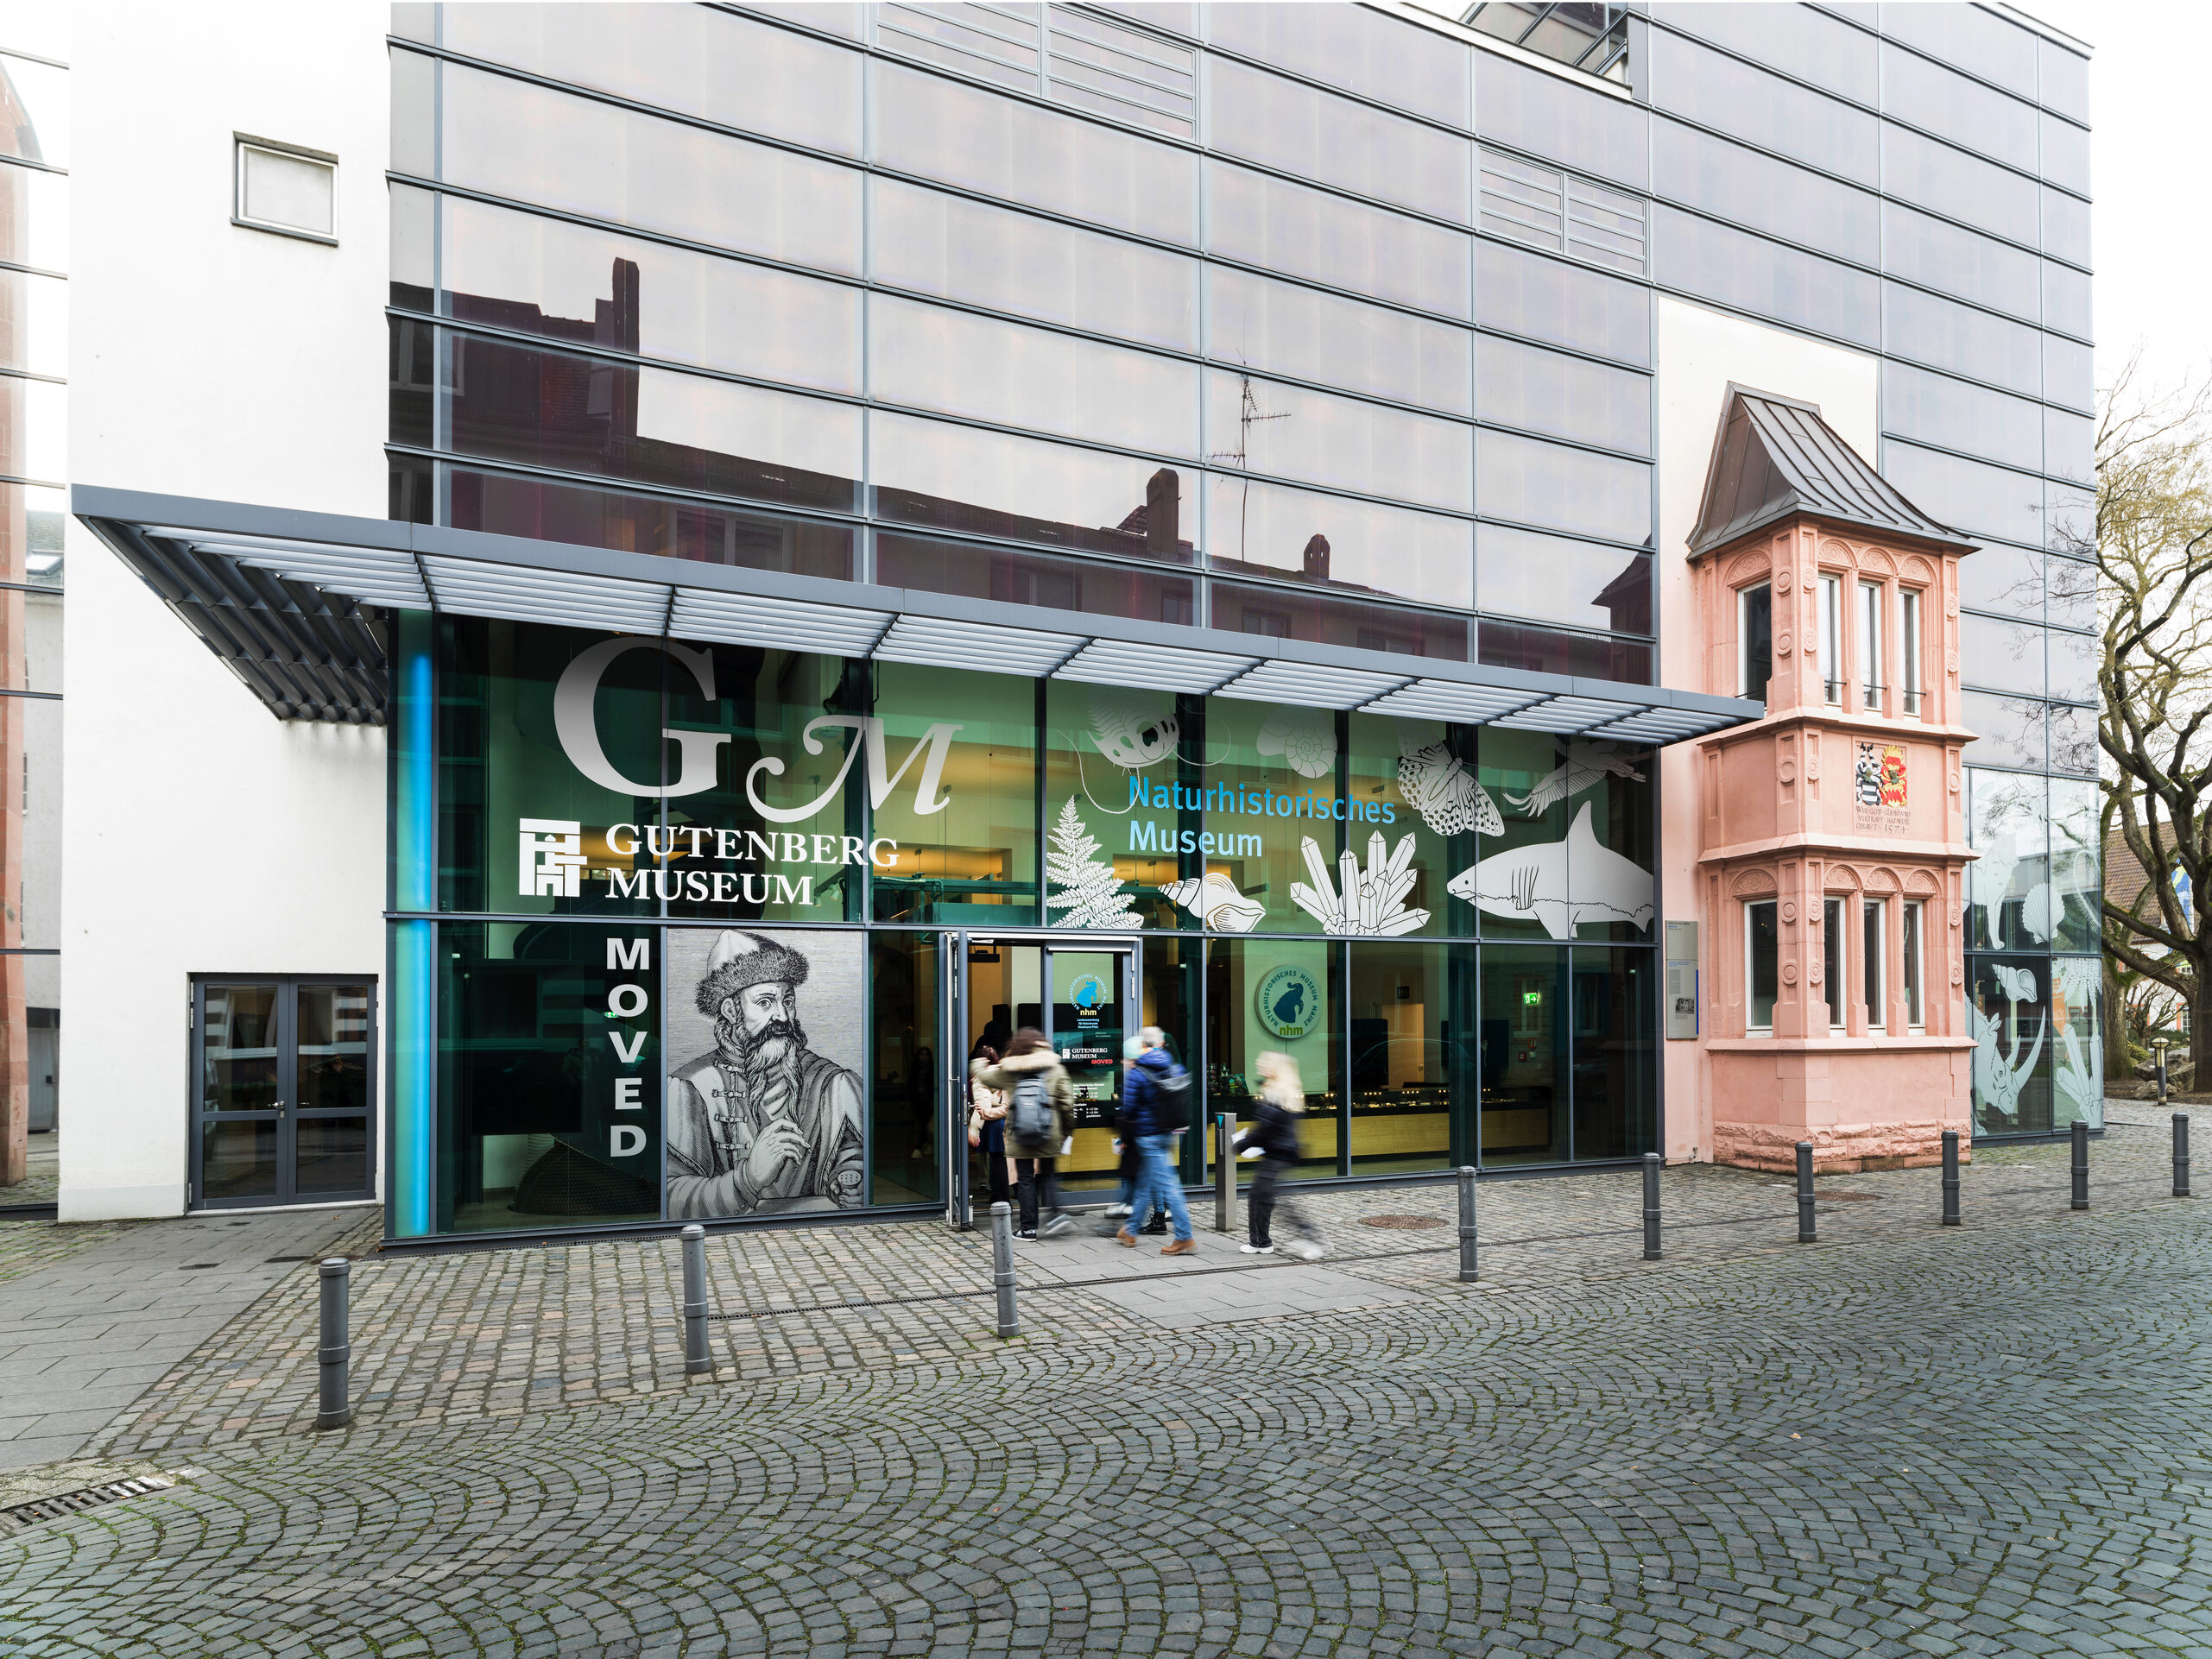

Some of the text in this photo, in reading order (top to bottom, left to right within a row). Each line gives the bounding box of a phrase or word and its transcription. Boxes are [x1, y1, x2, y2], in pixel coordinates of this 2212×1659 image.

[553, 636, 963, 823] G M
[1128, 775, 1395, 824] Naturhistorisches
[605, 823, 899, 867] GUTENBERG
[1128, 820, 1262, 857] Museum
[606, 867, 814, 905] MUSEUM
[1069, 974, 1107, 1010] NATURHISTORISCHES MUSEUM MAINZ
[1263, 970, 1318, 1027] NATURHISTORISCHES MUSEUM MAINZ
[606, 937, 649, 1158] MOVED
[1280, 1025, 1303, 1036] nhm
